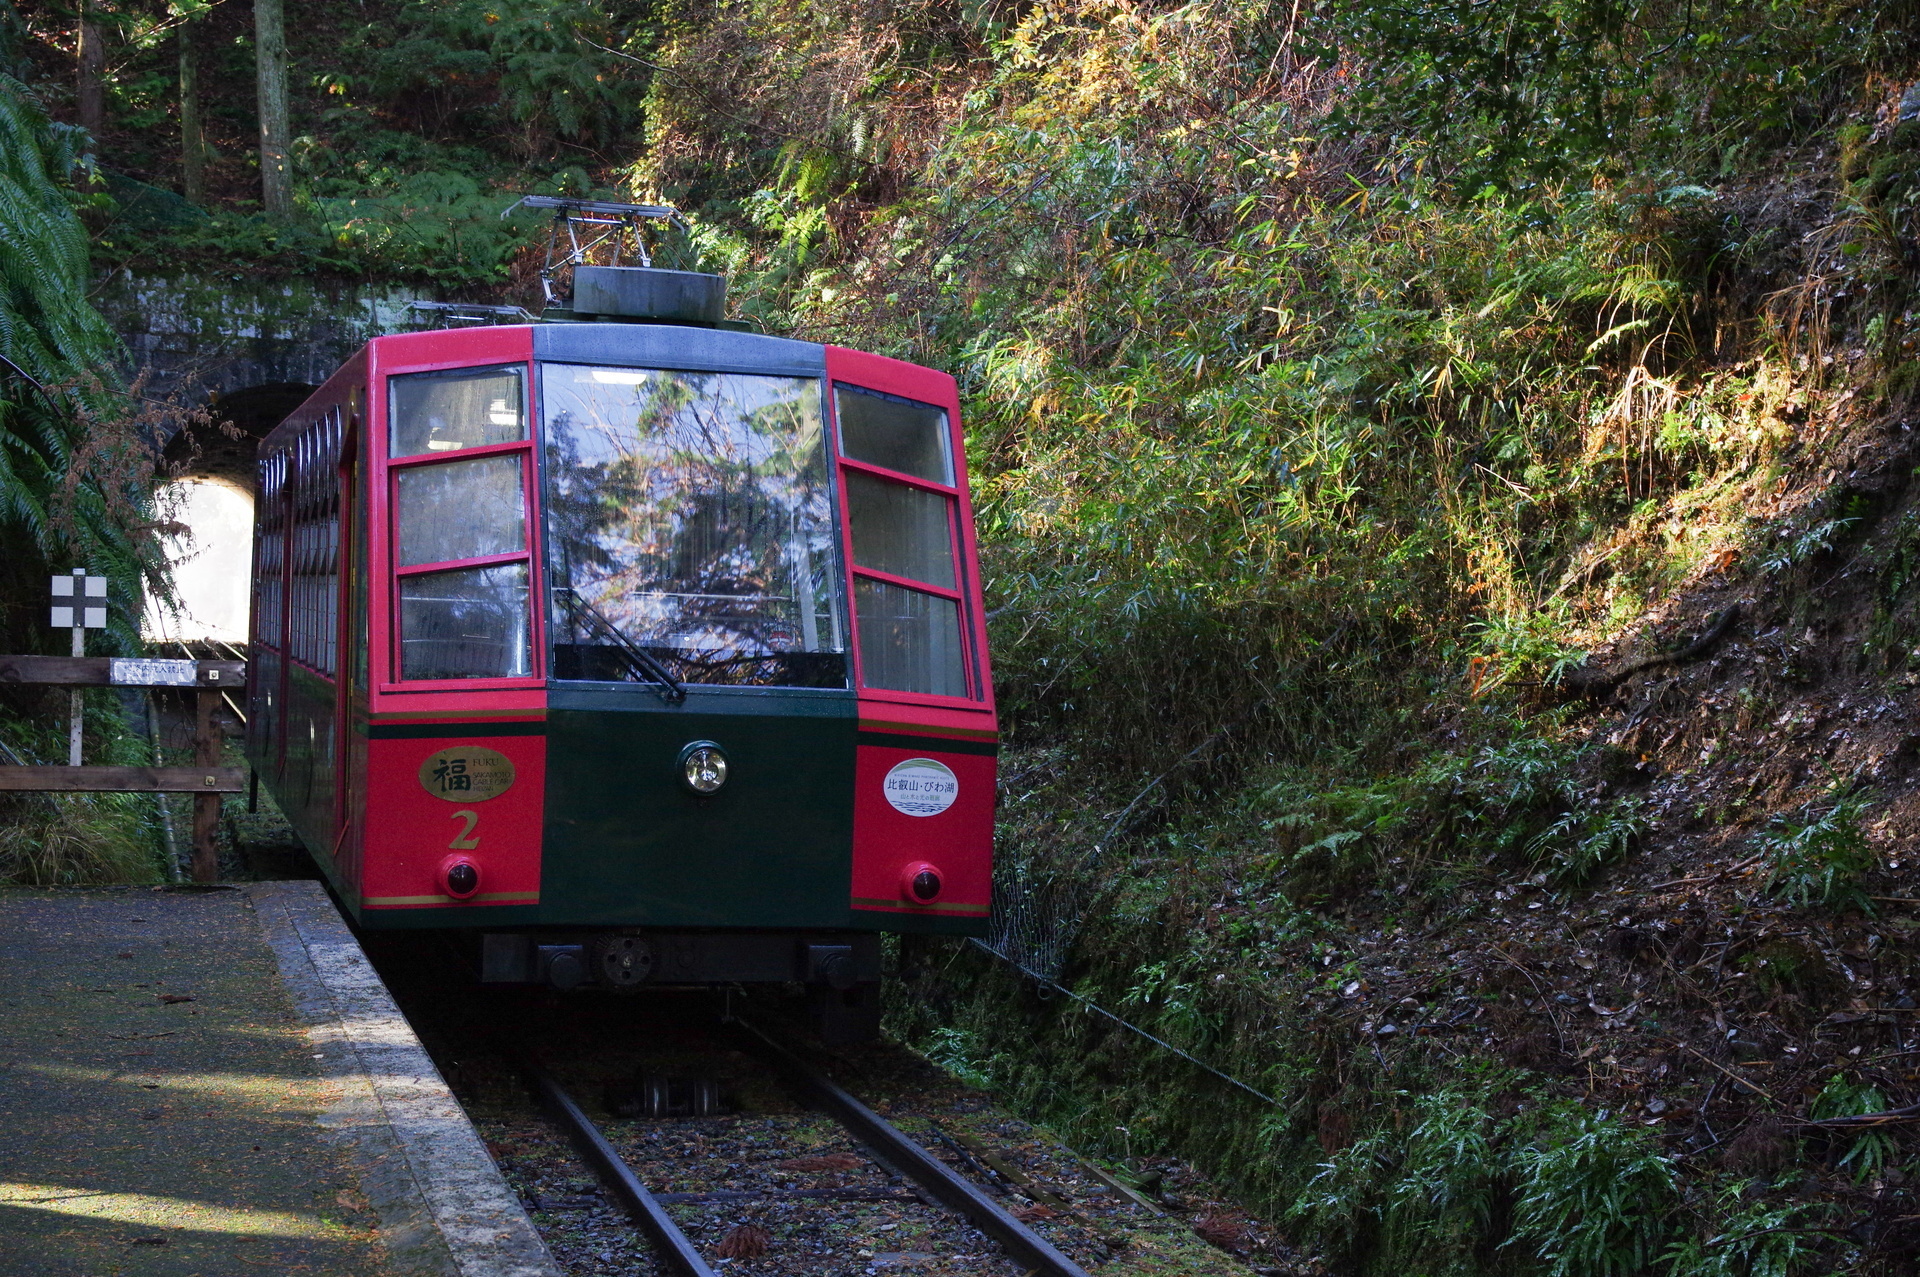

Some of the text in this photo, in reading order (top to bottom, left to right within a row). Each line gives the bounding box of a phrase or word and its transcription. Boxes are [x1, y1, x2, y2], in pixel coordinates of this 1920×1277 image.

[433, 759, 471, 792] 福
[473, 758, 499, 766] FUKU
[448, 810, 480, 850] 2
